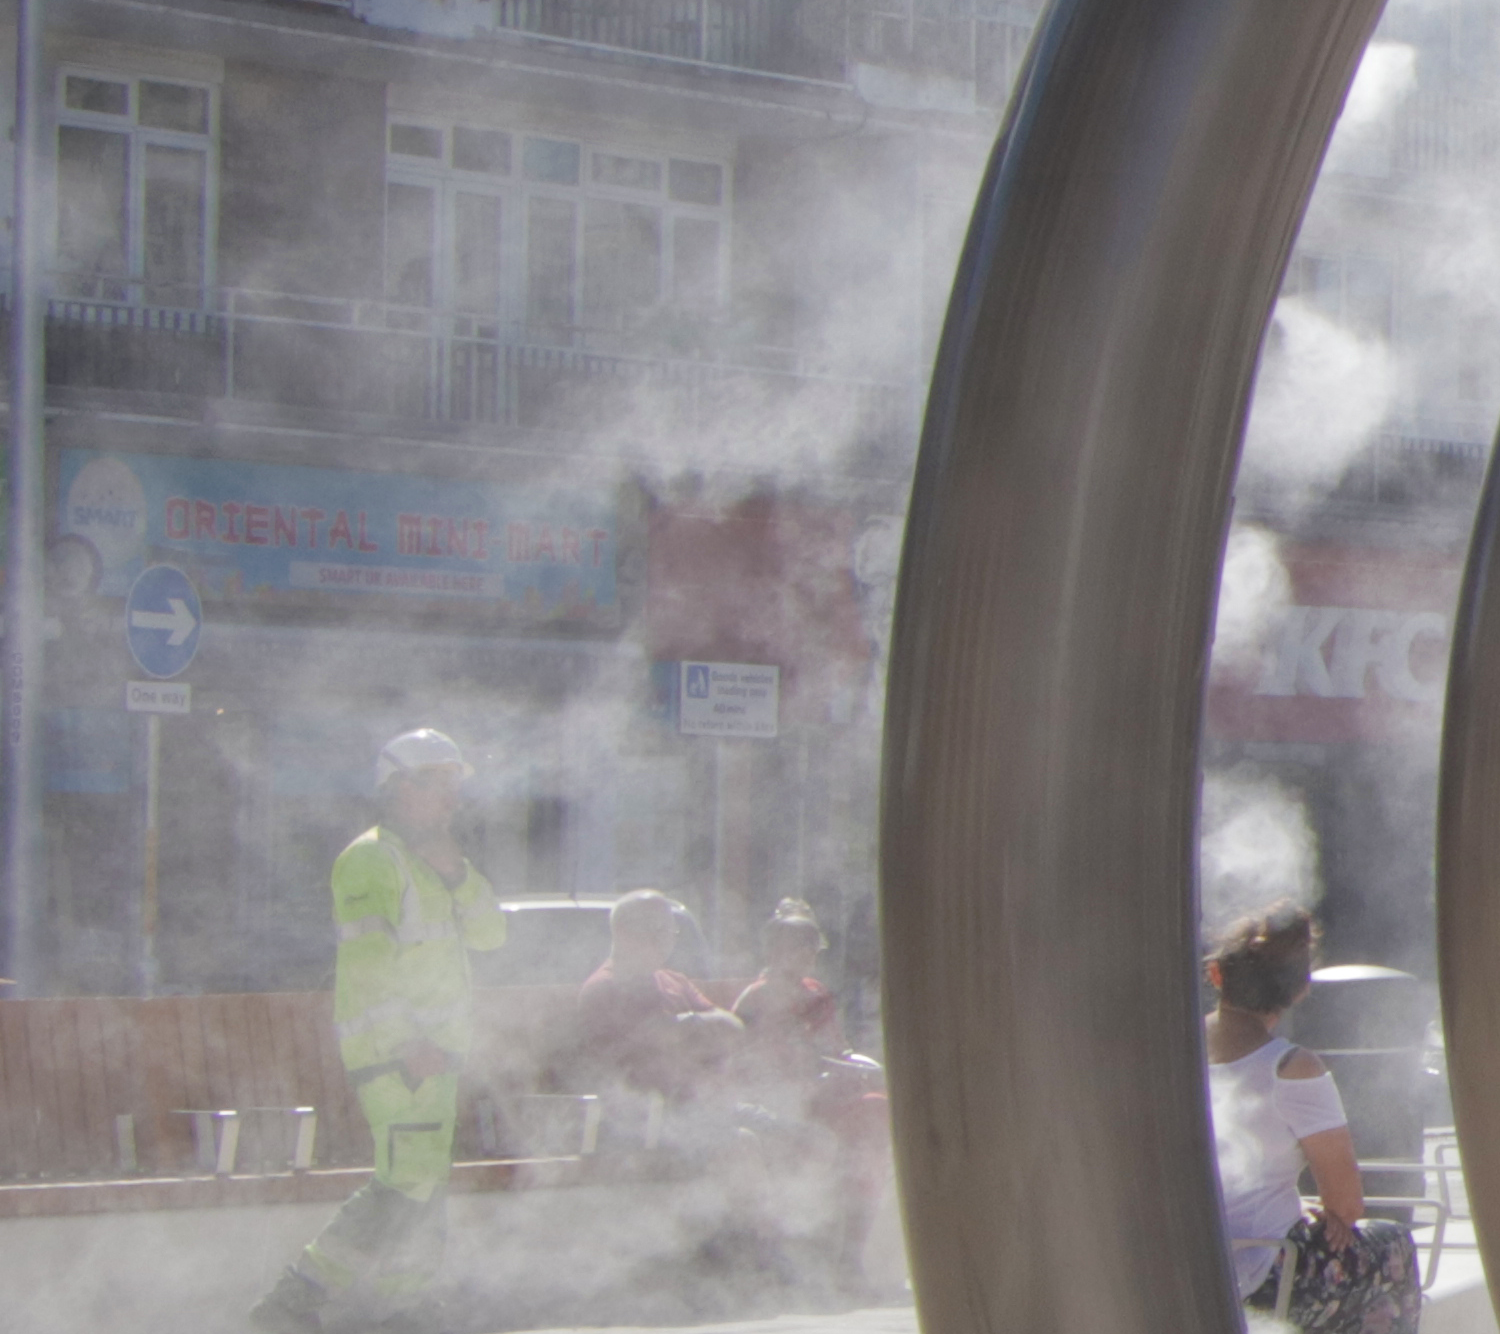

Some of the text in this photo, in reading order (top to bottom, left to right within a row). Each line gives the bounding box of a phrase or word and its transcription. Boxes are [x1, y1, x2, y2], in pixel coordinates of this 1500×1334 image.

[75, 505, 139, 528] SMART
[165, 498, 609, 567] ORIENTAL MINI-MART
[1252, 605, 1447, 701] KFC
[131, 687, 157, 703] One
